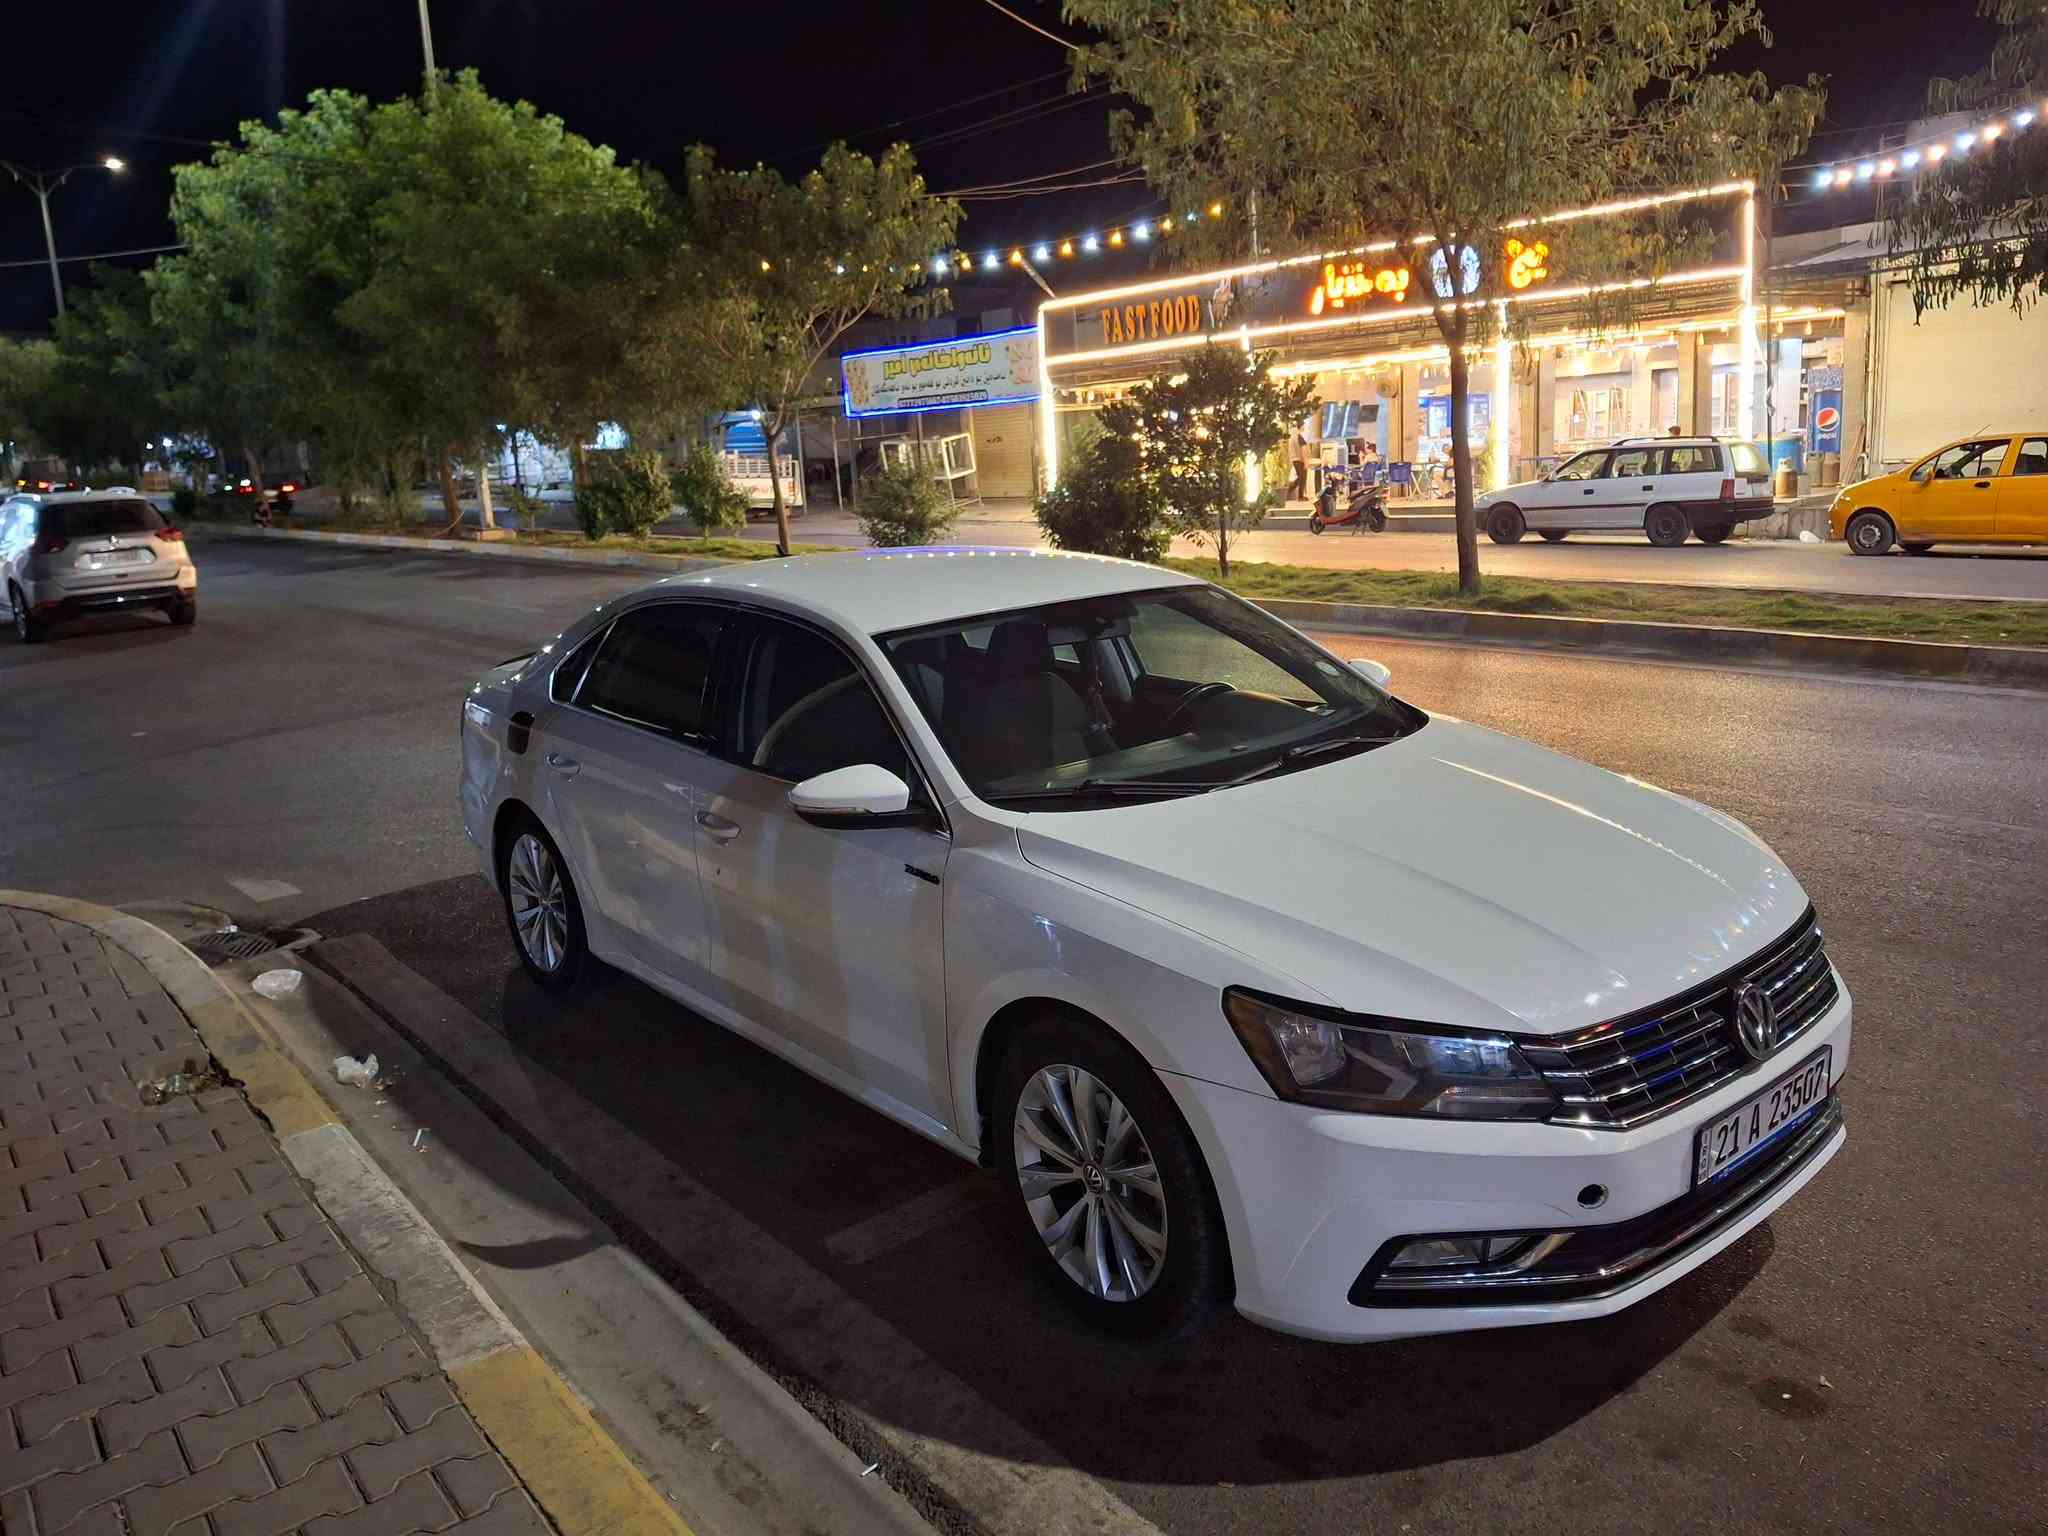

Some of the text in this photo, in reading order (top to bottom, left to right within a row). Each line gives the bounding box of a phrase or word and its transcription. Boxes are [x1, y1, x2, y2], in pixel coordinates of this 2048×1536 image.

[1102, 295, 1200, 344] FAST FOOD
[1715, 1116, 1741, 1166] 21
[1749, 1103, 1761, 1145] A
[1768, 1058, 1826, 1131] 23507
